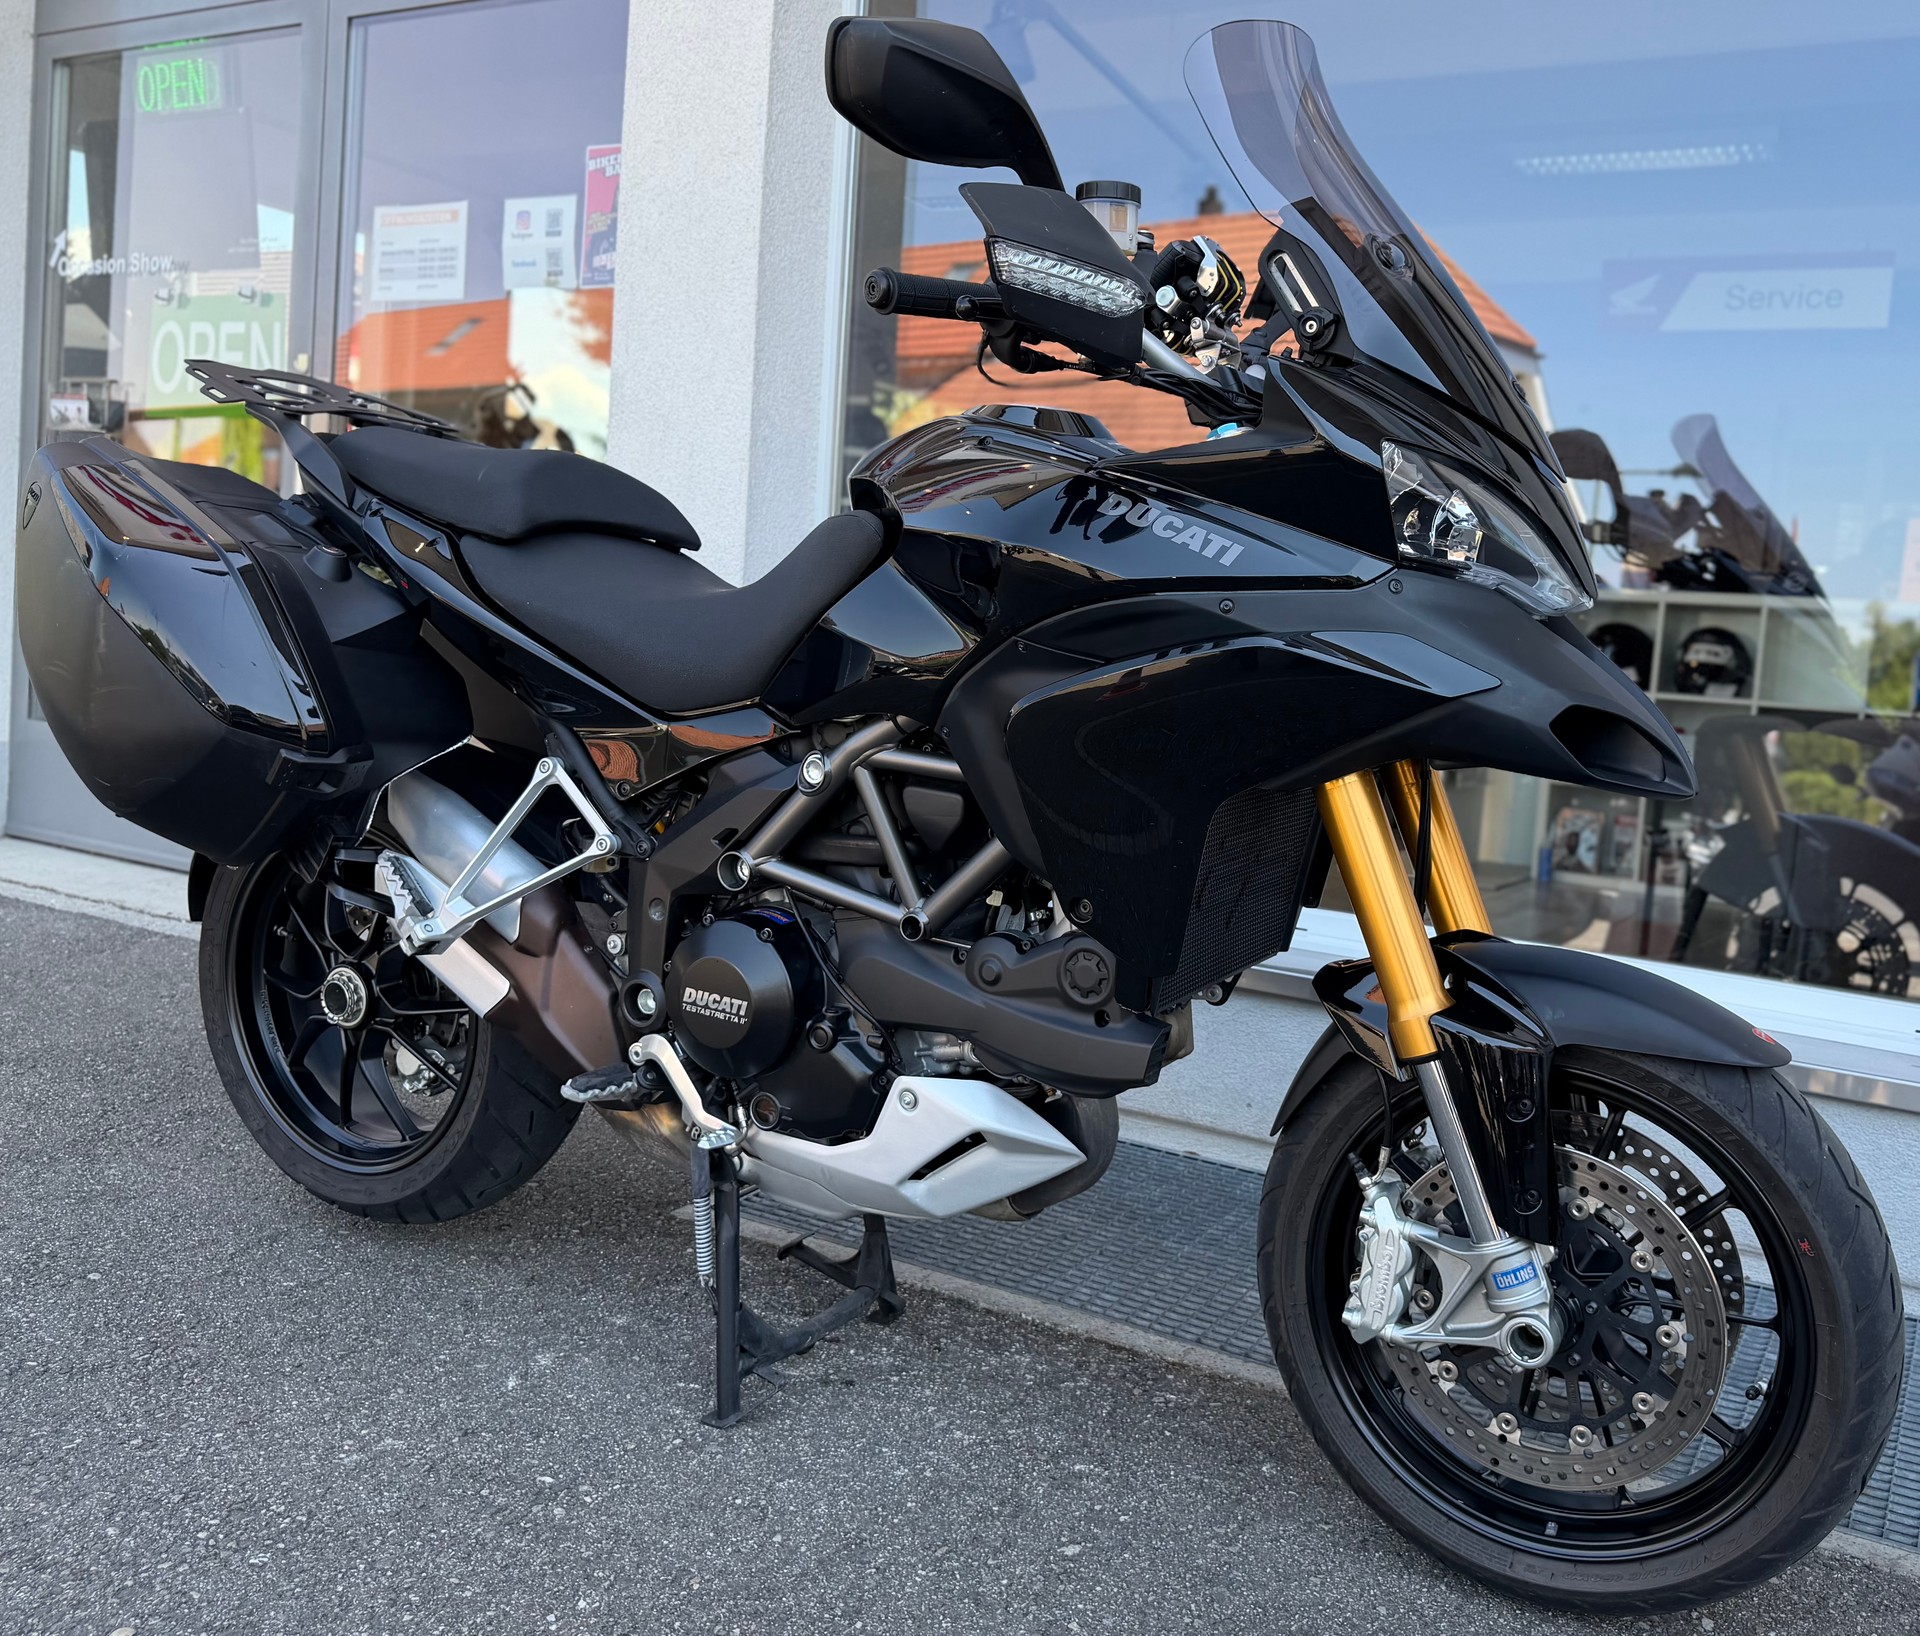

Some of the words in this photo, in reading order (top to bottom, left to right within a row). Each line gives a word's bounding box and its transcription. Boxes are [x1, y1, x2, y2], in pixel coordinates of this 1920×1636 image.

[138, 58, 206, 113] OPEN
[129, 252, 174, 273] Show
[1725, 283, 1844, 311] Service
[152, 320, 282, 394] OPEN
[1097, 493, 1245, 567] DUCATI
[682, 1003, 738, 1023] TESTASTRETTA
[683, 986, 748, 1016] DUCATI
[1370, 1251, 1393, 1312] brembo
[1496, 1265, 1536, 1290] ÖHLINS
